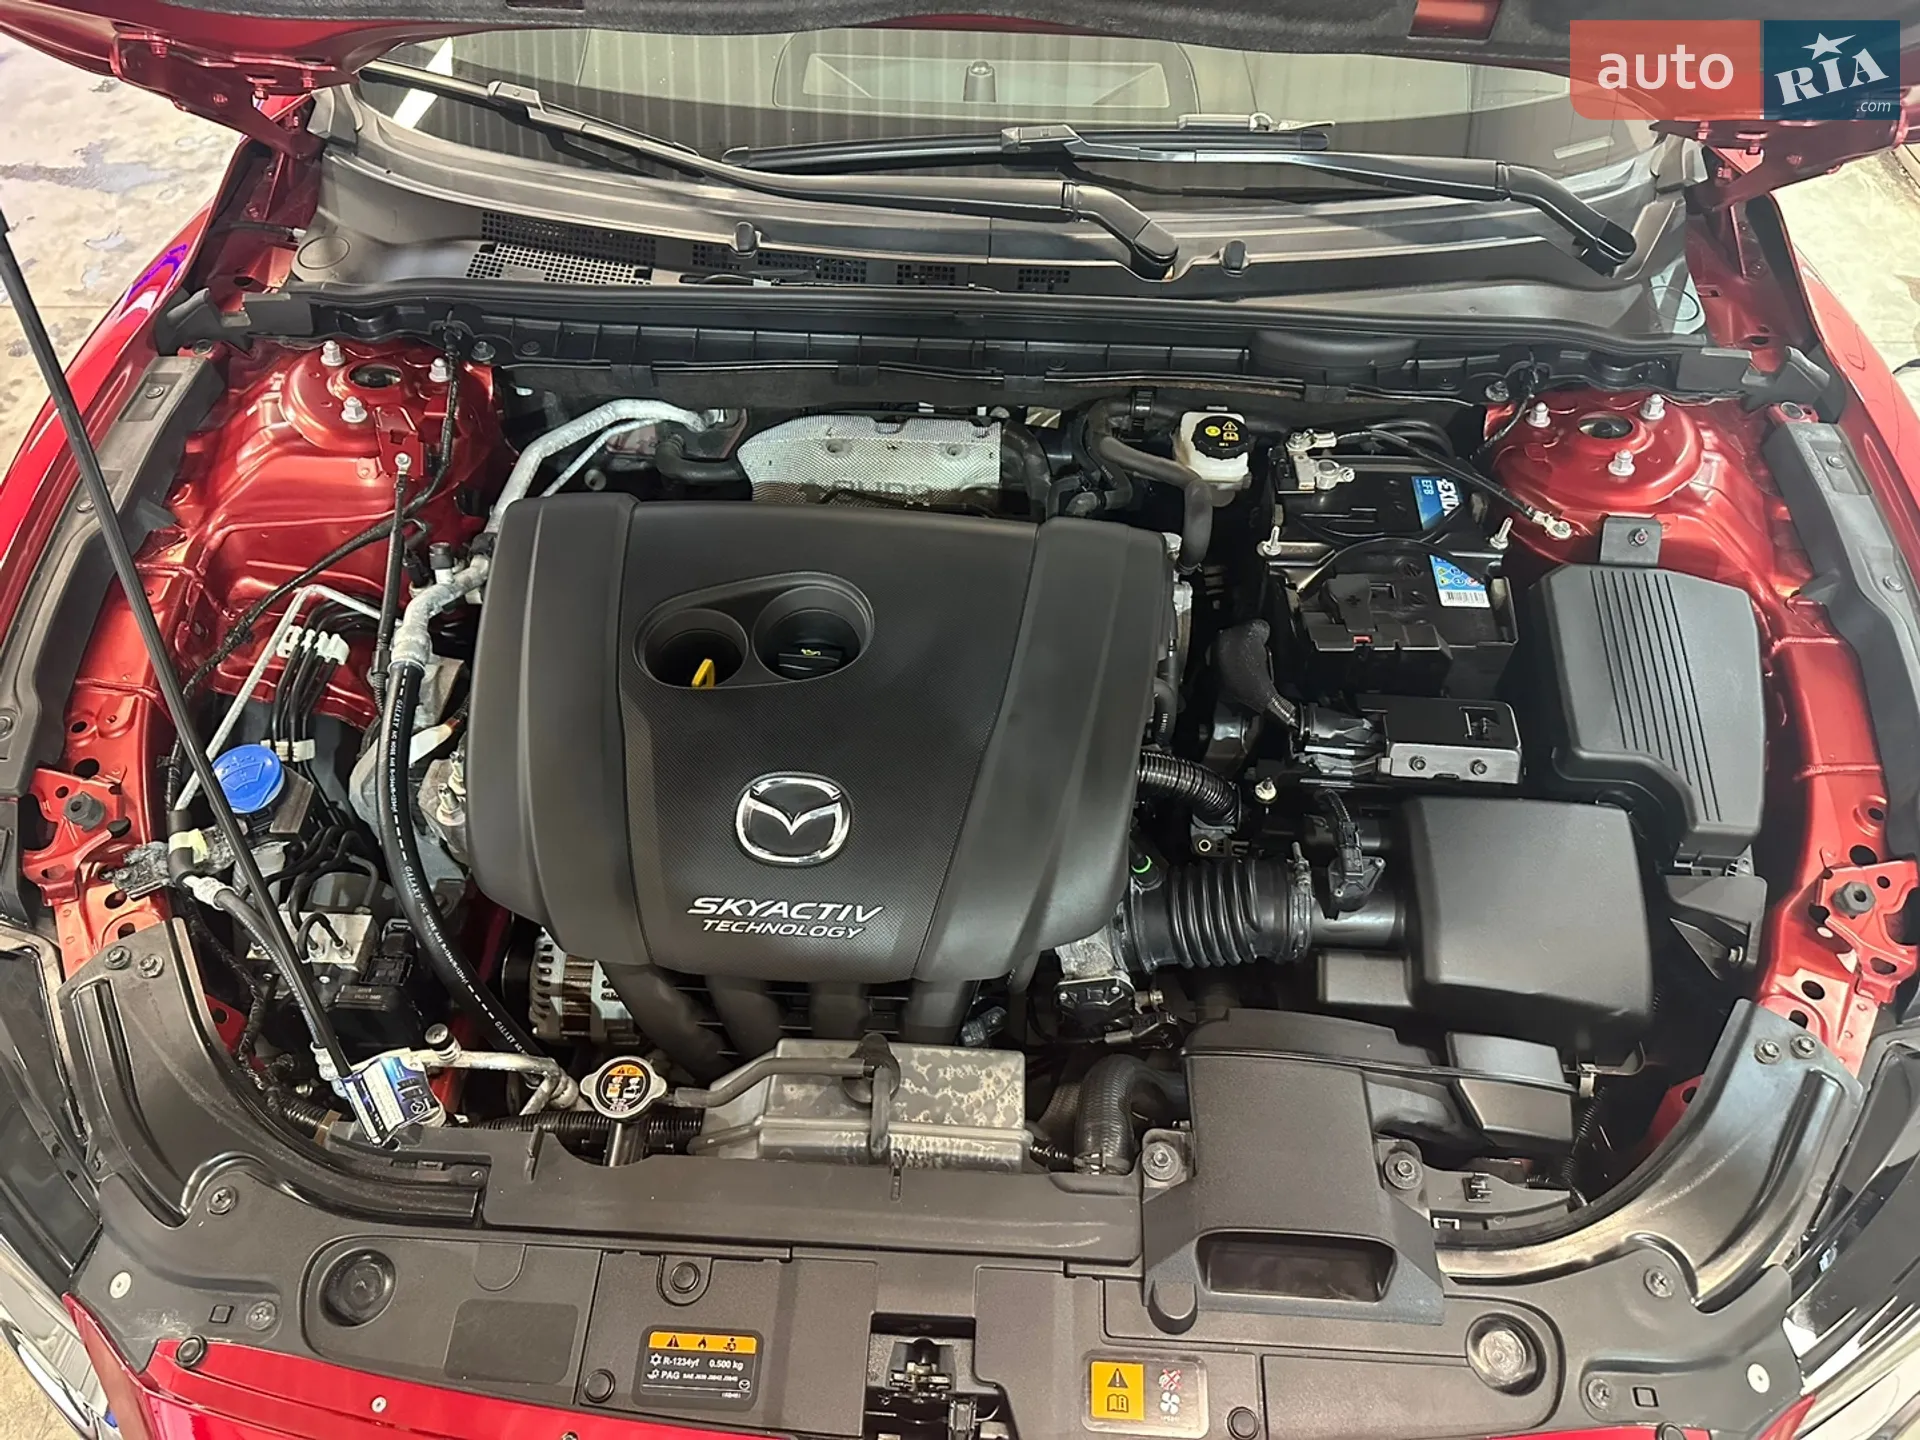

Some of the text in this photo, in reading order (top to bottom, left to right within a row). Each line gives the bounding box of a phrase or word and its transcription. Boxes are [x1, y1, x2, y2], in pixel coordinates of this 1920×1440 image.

[1421, 479, 1435, 495] EFB
[404, 865, 424, 900] GALAXY
[687, 897, 884, 924] SKYACTIV
[702, 919, 864, 940] TECHNOLOGY
[662, 1356, 744, 1372] R-1234yf 0.500 kg
[660, 1370, 681, 1380] PAG
